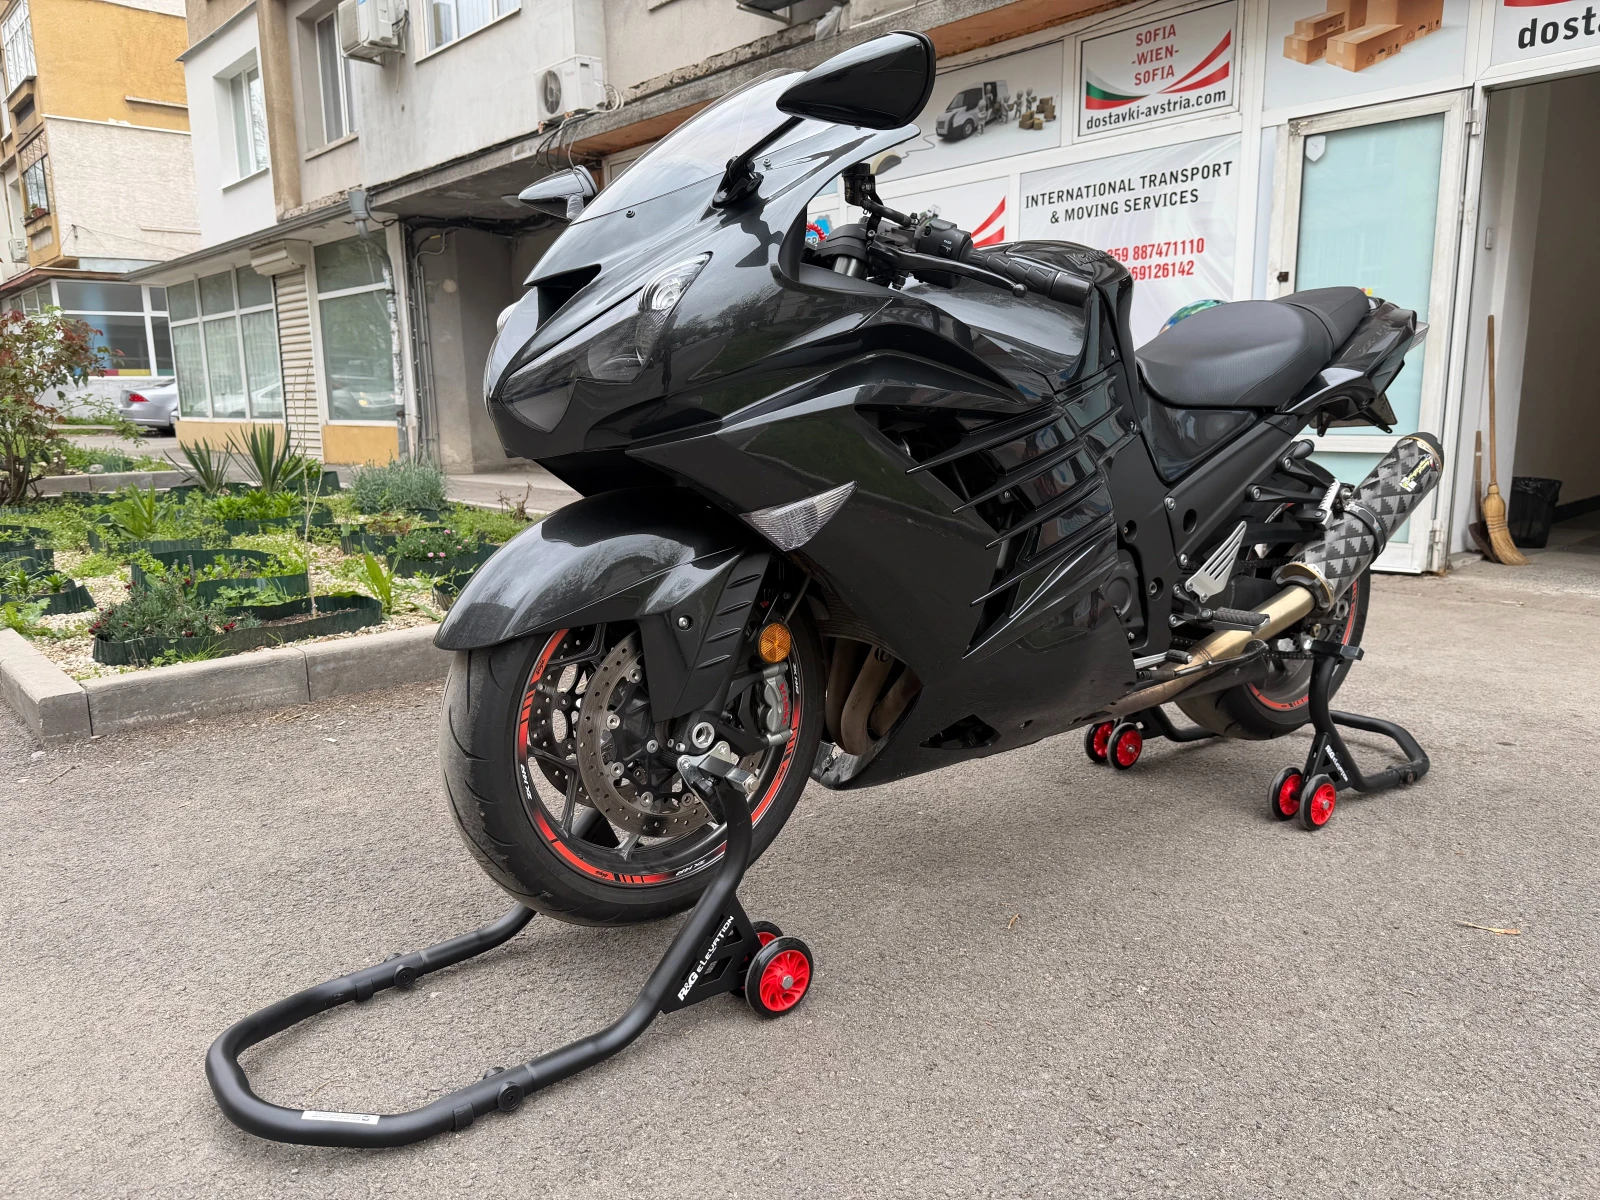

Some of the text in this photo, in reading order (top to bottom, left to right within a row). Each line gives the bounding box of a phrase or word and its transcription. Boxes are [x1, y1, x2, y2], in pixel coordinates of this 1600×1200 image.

[1136, 24, 1176, 47] SOFIA
[1518, 6, 1600, 50] dost
[1132, 44, 1179, 66] -WIEN-
[1134, 65, 1175, 86] SOFIA
[1086, 90, 1226, 130] dostavki-avstria.com
[1025, 161, 1233, 209] INTERNATIONAL TRANSPORT
[1050, 188, 1199, 224] & MOVING SERVICES
[1132, 237, 1205, 261] 887471110
[677, 971, 699, 1002] R&G
